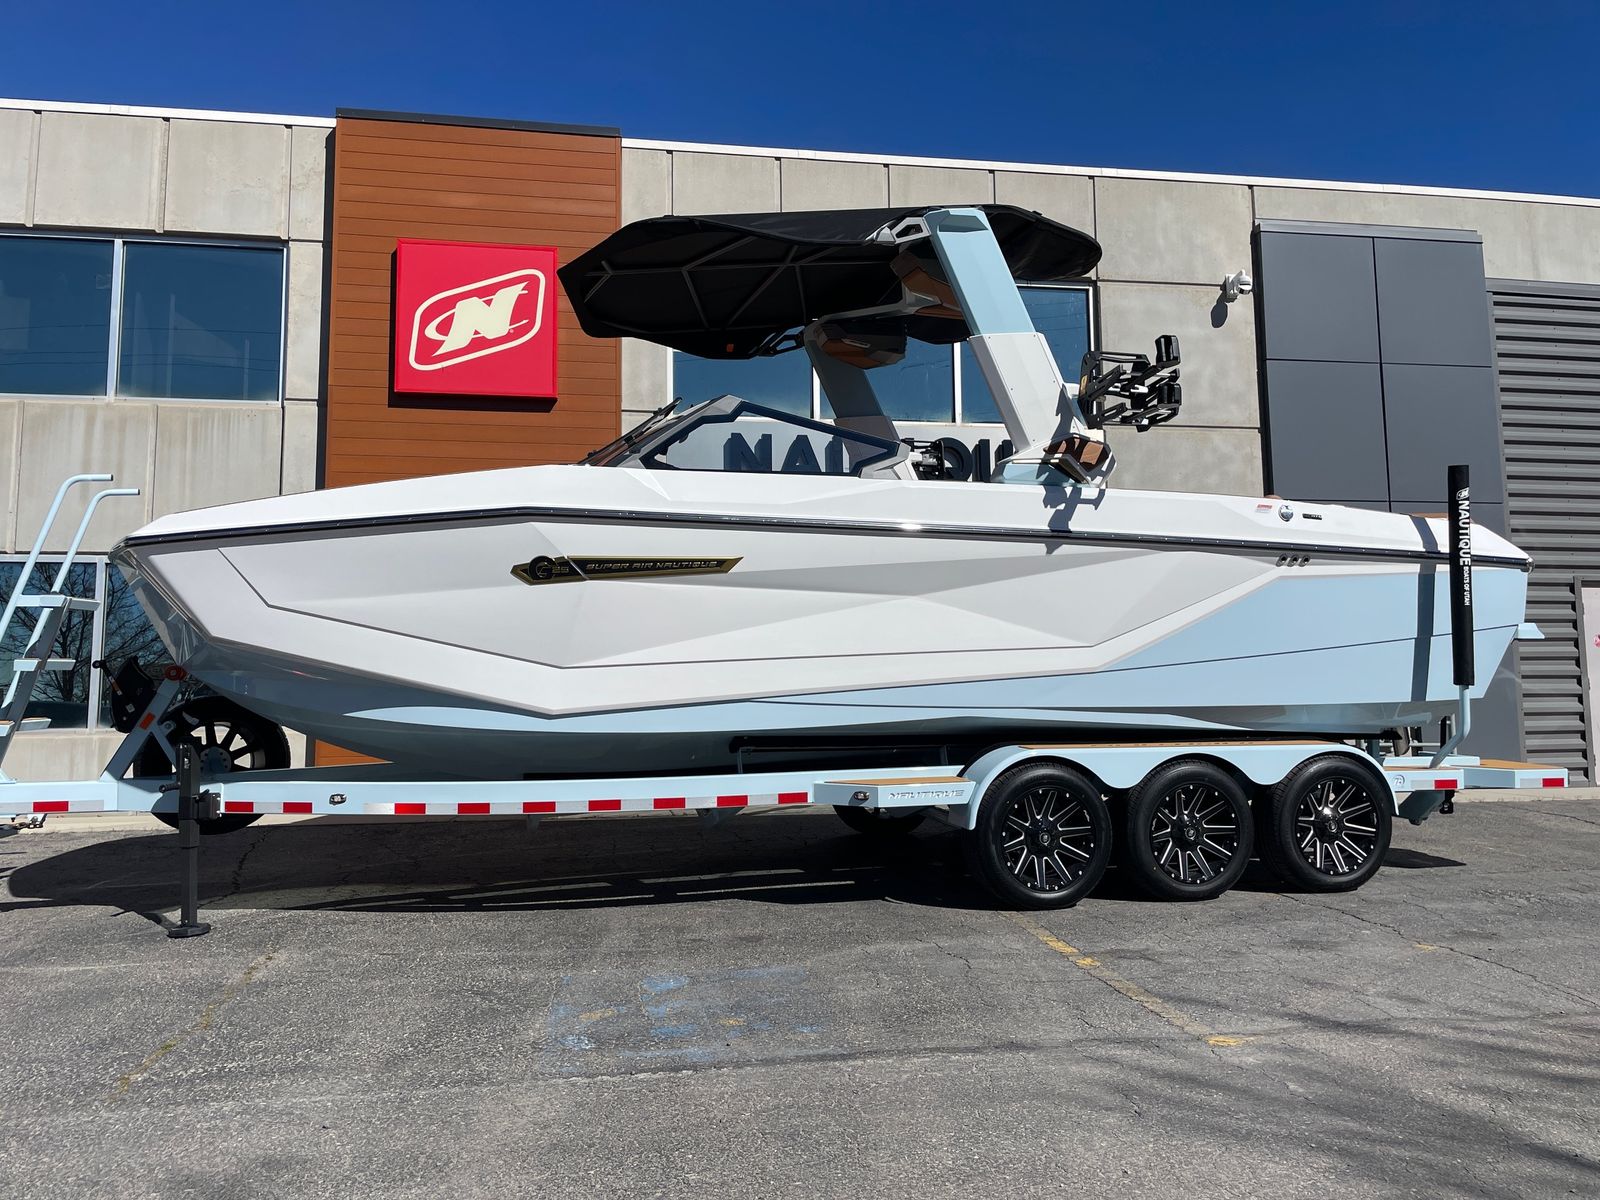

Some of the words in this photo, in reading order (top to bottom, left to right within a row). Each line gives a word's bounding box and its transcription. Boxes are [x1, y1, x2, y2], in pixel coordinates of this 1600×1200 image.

[1458, 500, 1471, 566] NAUTIQUE
[656, 561, 718, 569] NAUTIQUE
[888, 789, 965, 800] NAUTIQUE
